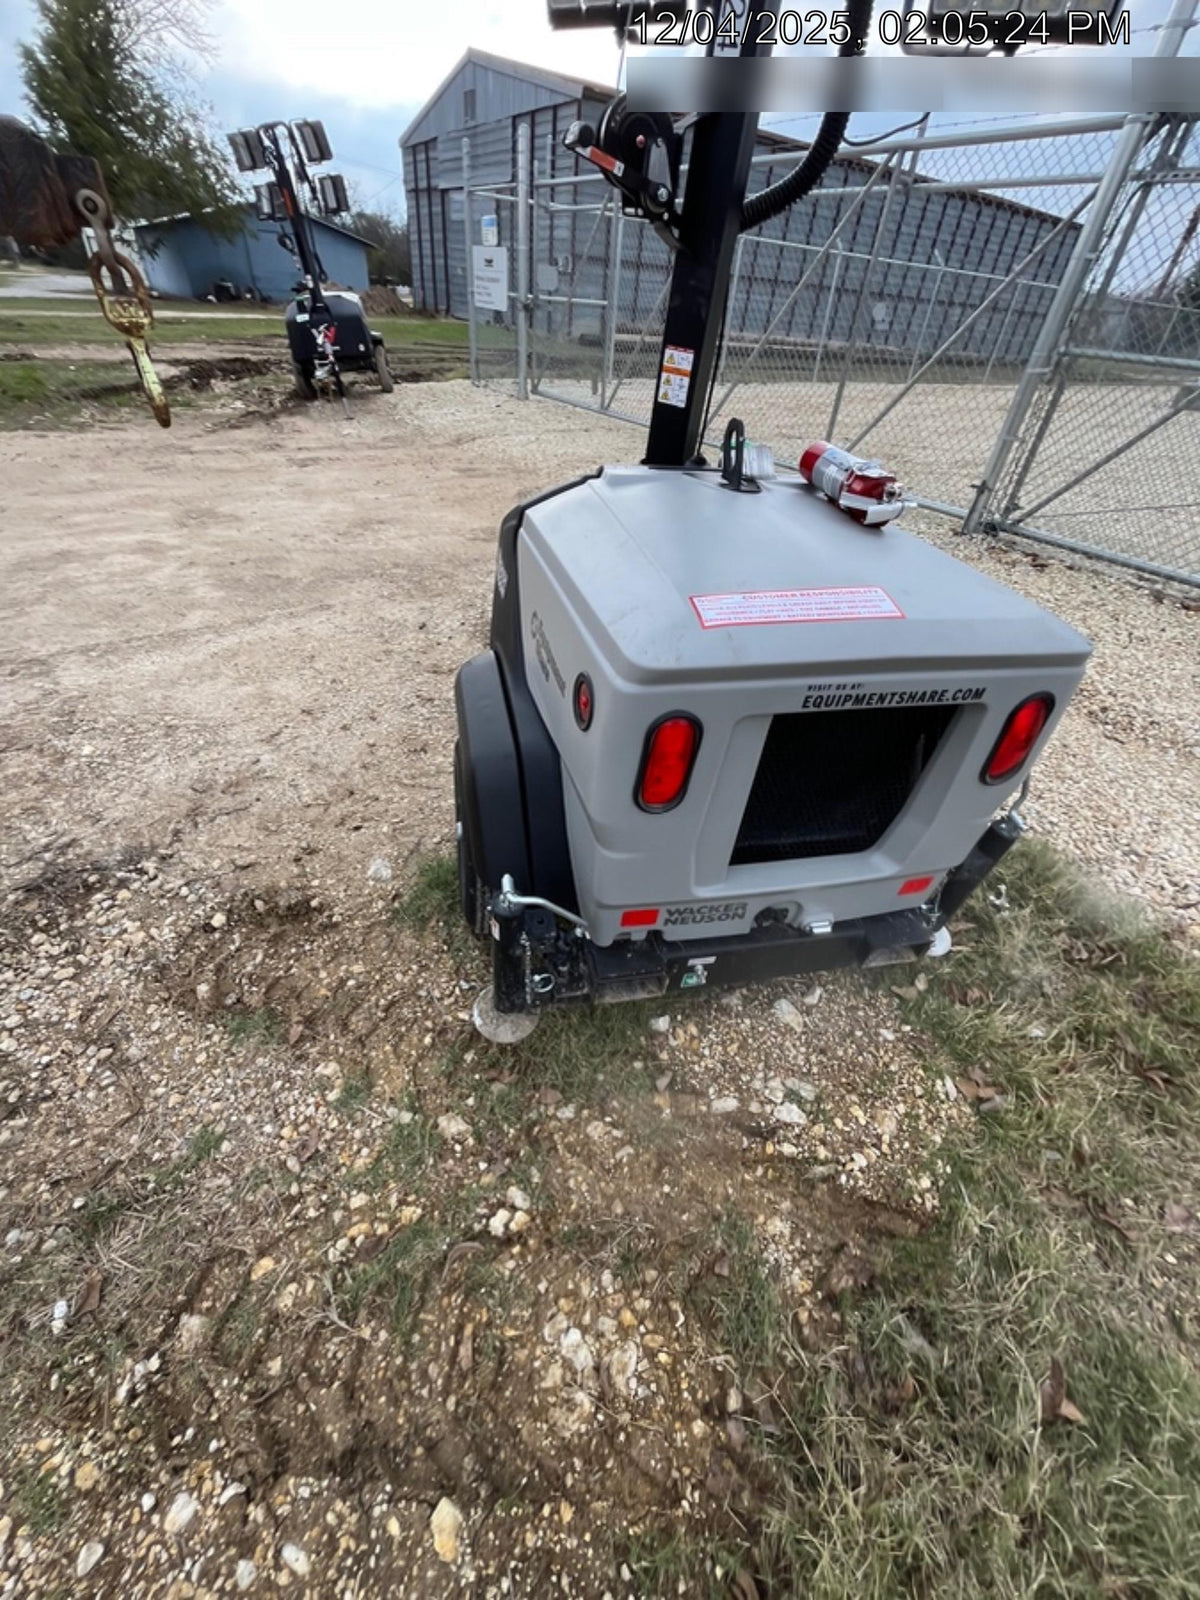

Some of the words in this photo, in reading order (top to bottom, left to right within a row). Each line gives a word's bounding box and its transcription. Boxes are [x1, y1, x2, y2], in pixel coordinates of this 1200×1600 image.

[807, 683, 832, 692] VISIT
[835, 683, 848, 691] US
[801, 687, 987, 709] EQUIPMENTSHARE.COM
[665, 902, 749, 918] WACKER
[663, 911, 746, 927] NEUSON
